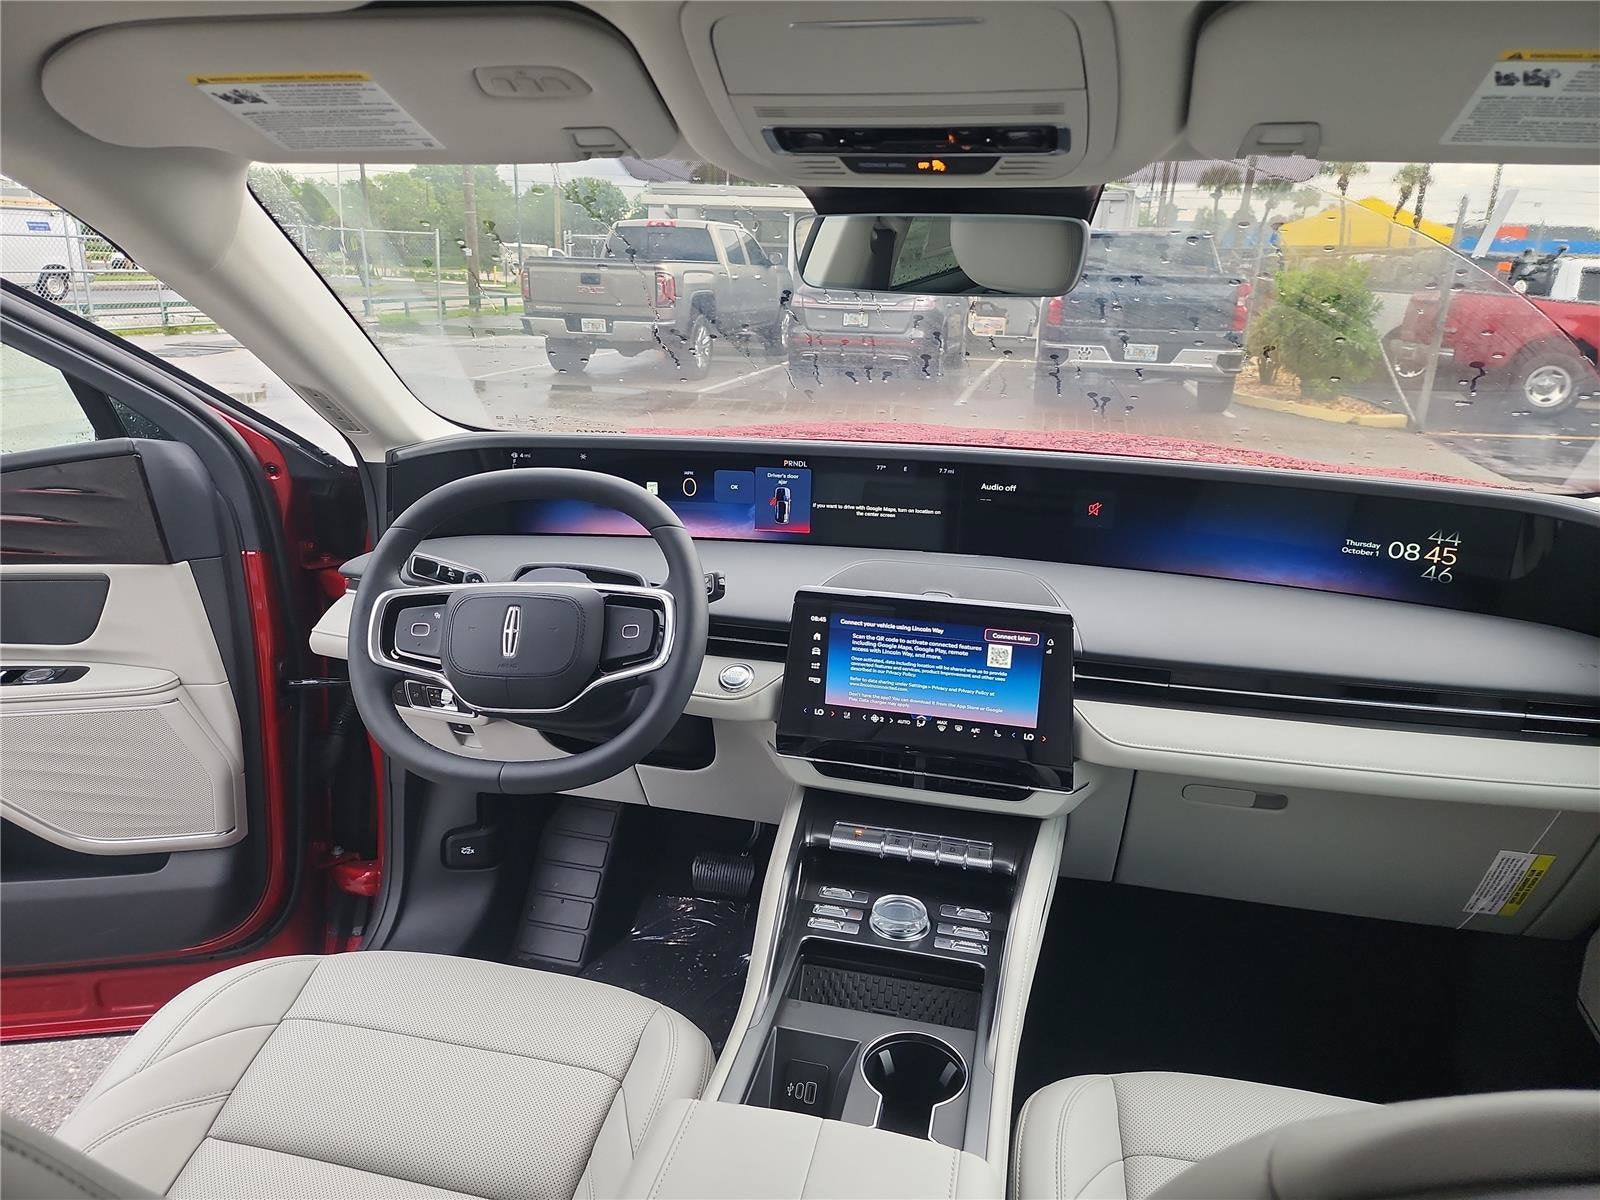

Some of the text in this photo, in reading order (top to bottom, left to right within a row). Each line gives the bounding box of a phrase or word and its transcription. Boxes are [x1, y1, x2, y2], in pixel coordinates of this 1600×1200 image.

[682, 478, 697, 497] 0
[980, 483, 1003, 491] Audio
[1345, 539, 1381, 549] Thursday
[1428, 529, 1462, 546] 44
[1341, 547, 1373, 556] October
[1388, 541, 1458, 566] 08 45
[1421, 566, 1453, 584] 46
